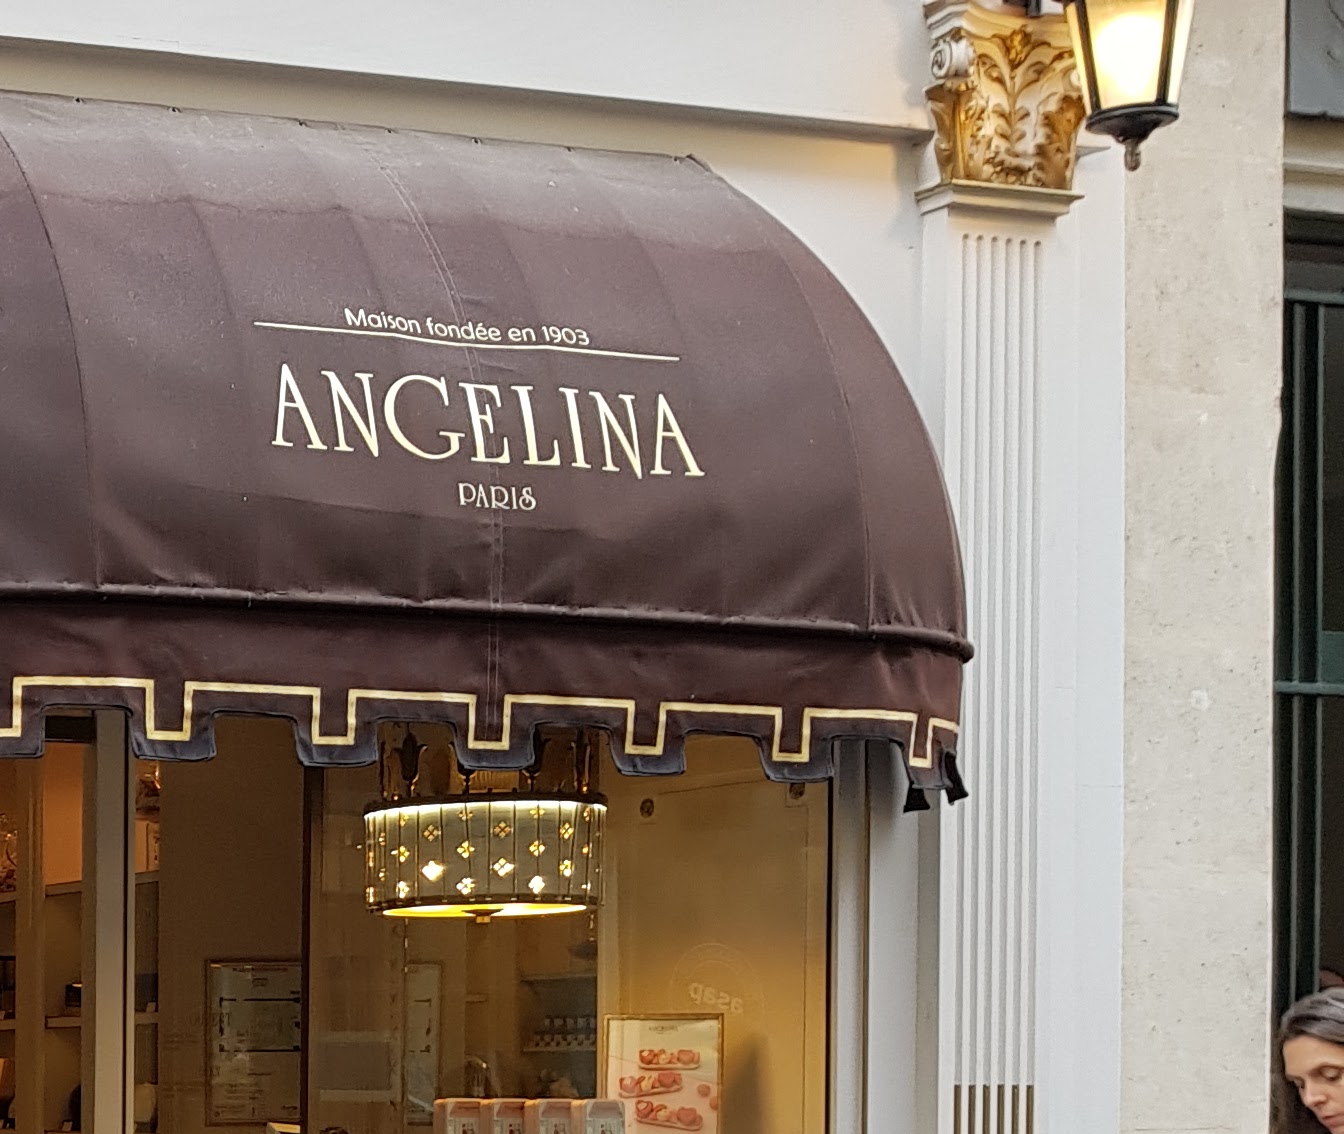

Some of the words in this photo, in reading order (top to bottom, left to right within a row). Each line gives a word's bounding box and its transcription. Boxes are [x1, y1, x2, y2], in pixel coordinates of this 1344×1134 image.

[344, 307, 422, 334] Maison
[425, 316, 502, 342] fondée
[507, 327, 537, 343] en
[541, 325, 590, 346] 1903
[271, 363, 705, 480] ANGELINA
[458, 482, 537, 511] PARIS
